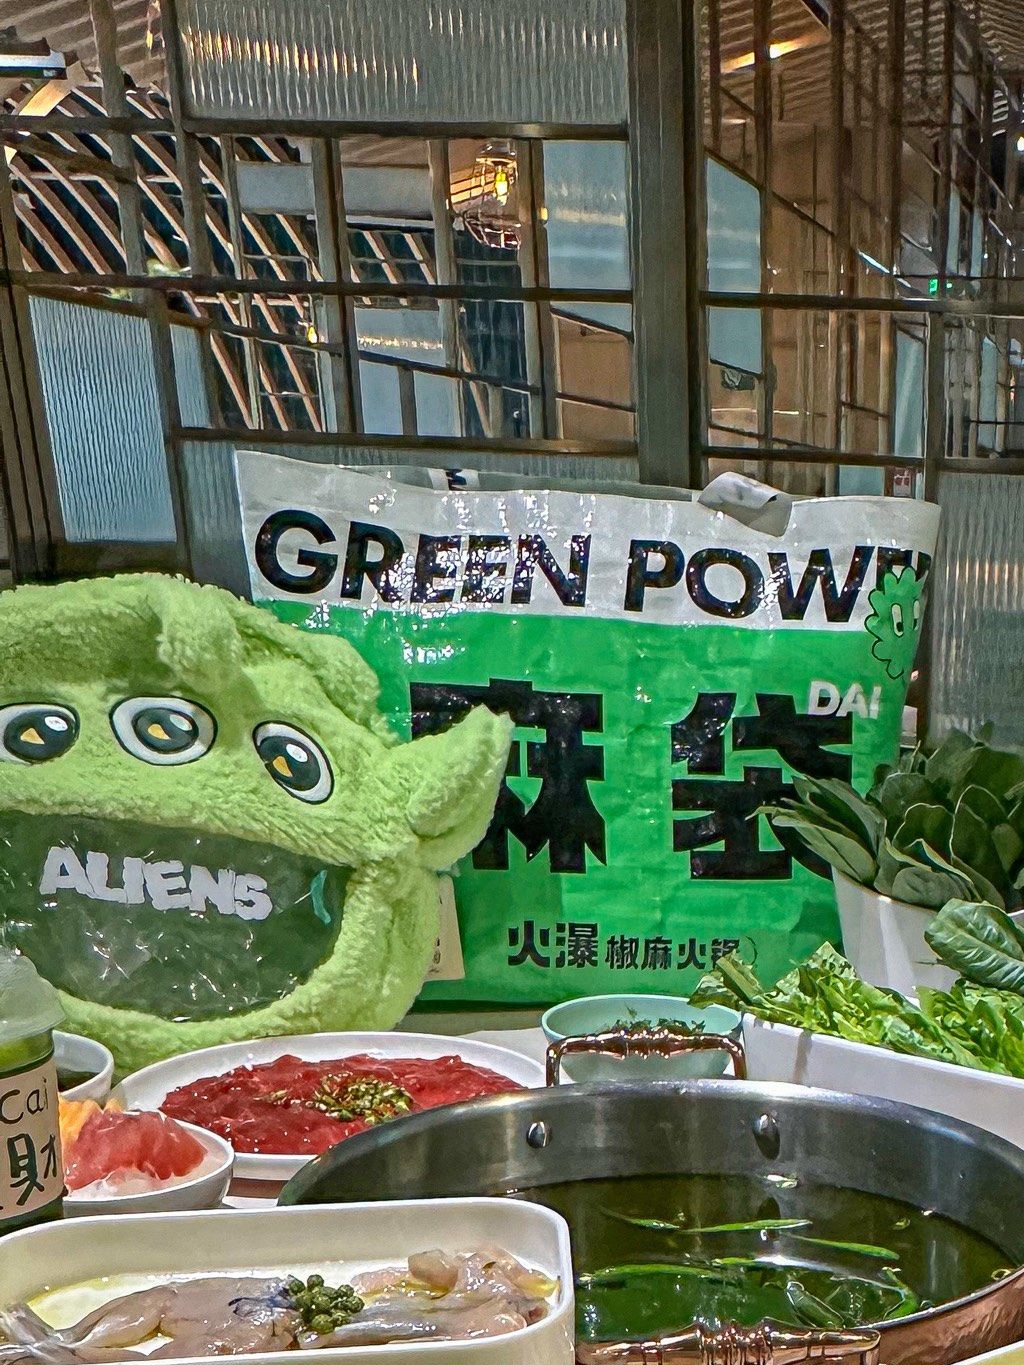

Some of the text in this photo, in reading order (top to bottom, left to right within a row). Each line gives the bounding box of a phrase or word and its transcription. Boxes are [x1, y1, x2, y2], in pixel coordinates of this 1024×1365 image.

[254, 509, 932, 624] GREEN POW
[807, 680, 882, 720] DAI
[39, 845, 273, 920] ALIENS
[0, 1076, 49, 1125] Cai
